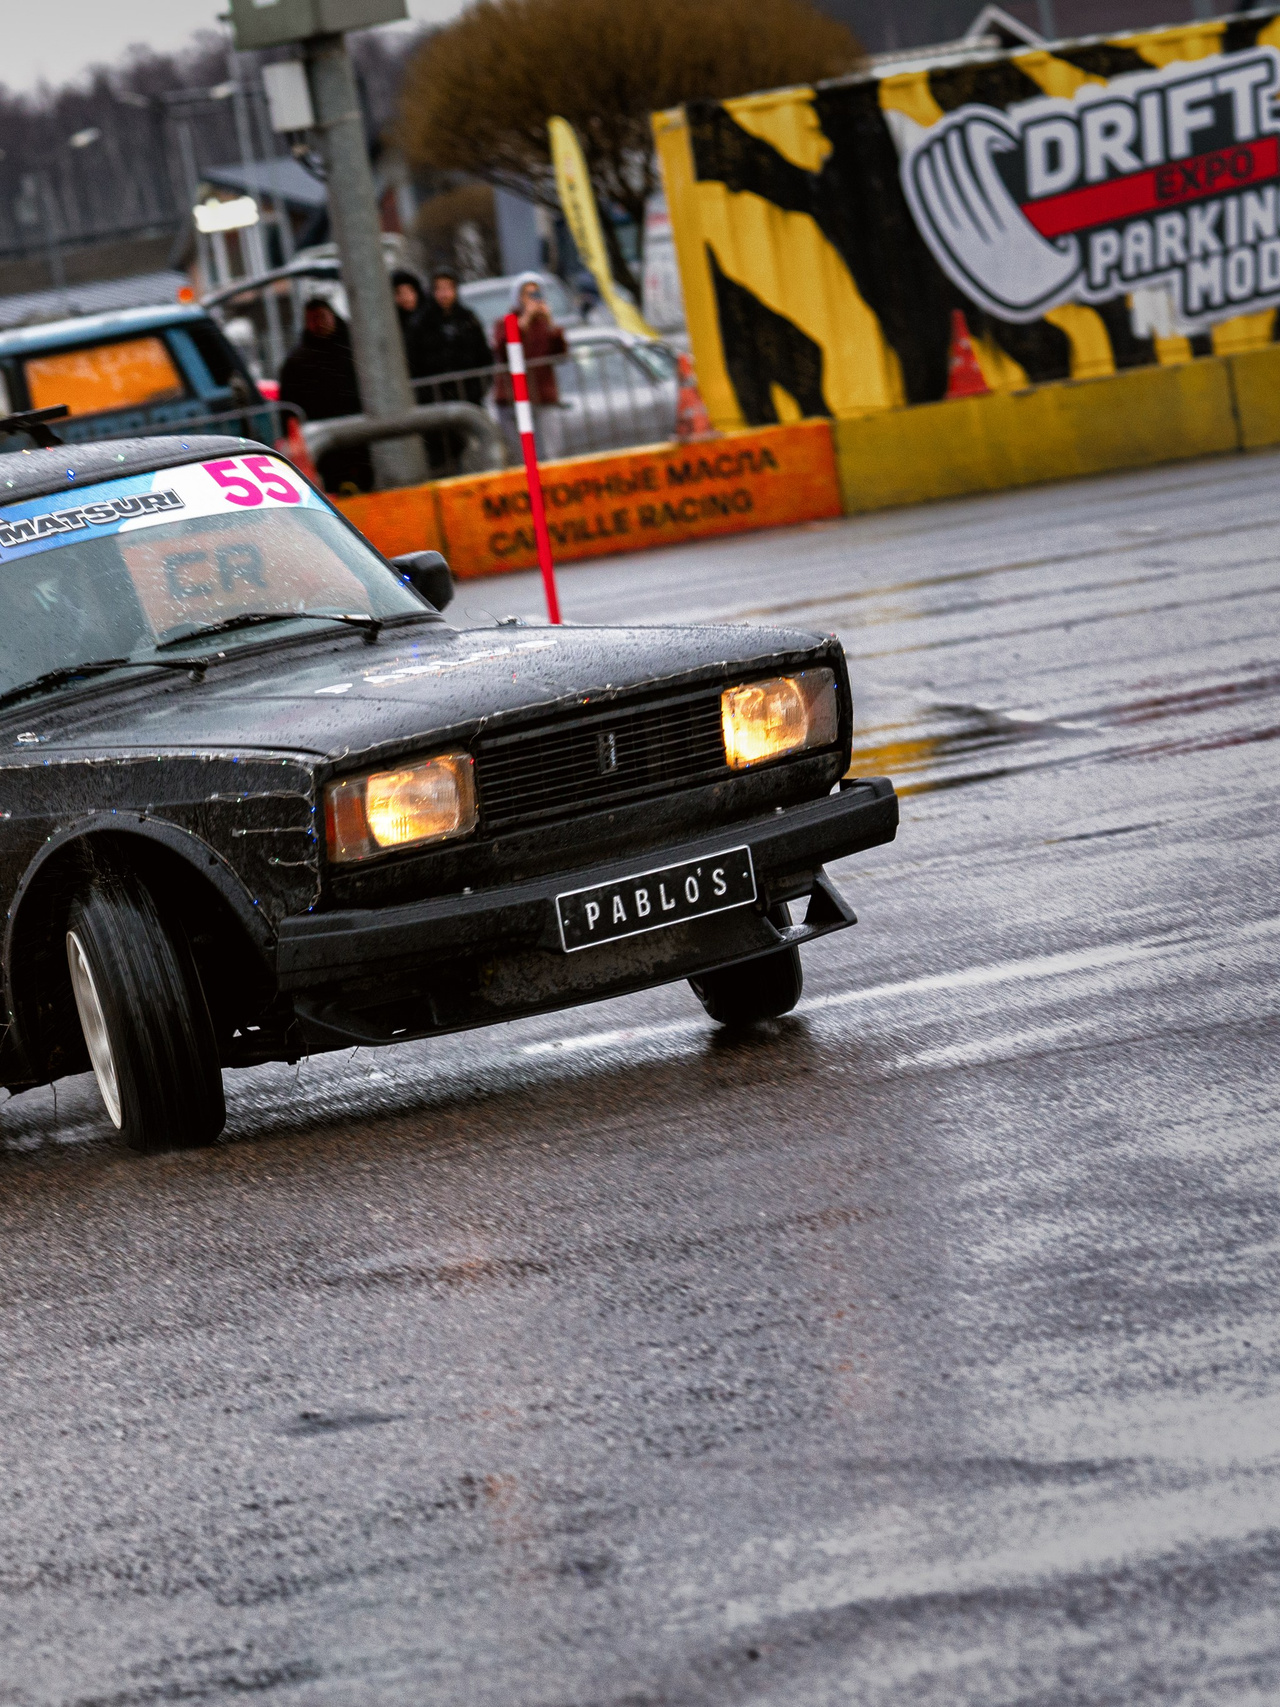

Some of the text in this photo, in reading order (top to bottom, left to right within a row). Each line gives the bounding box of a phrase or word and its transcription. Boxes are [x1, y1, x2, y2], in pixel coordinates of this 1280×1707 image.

[1155, 149, 1255, 202] EXPO
[201, 456, 301, 507] 55
[666, 447, 778, 487] МАСЛА
[488, 486, 754, 557] CAVILLE RACING
[584, 867, 727, 931] PABLO'S
